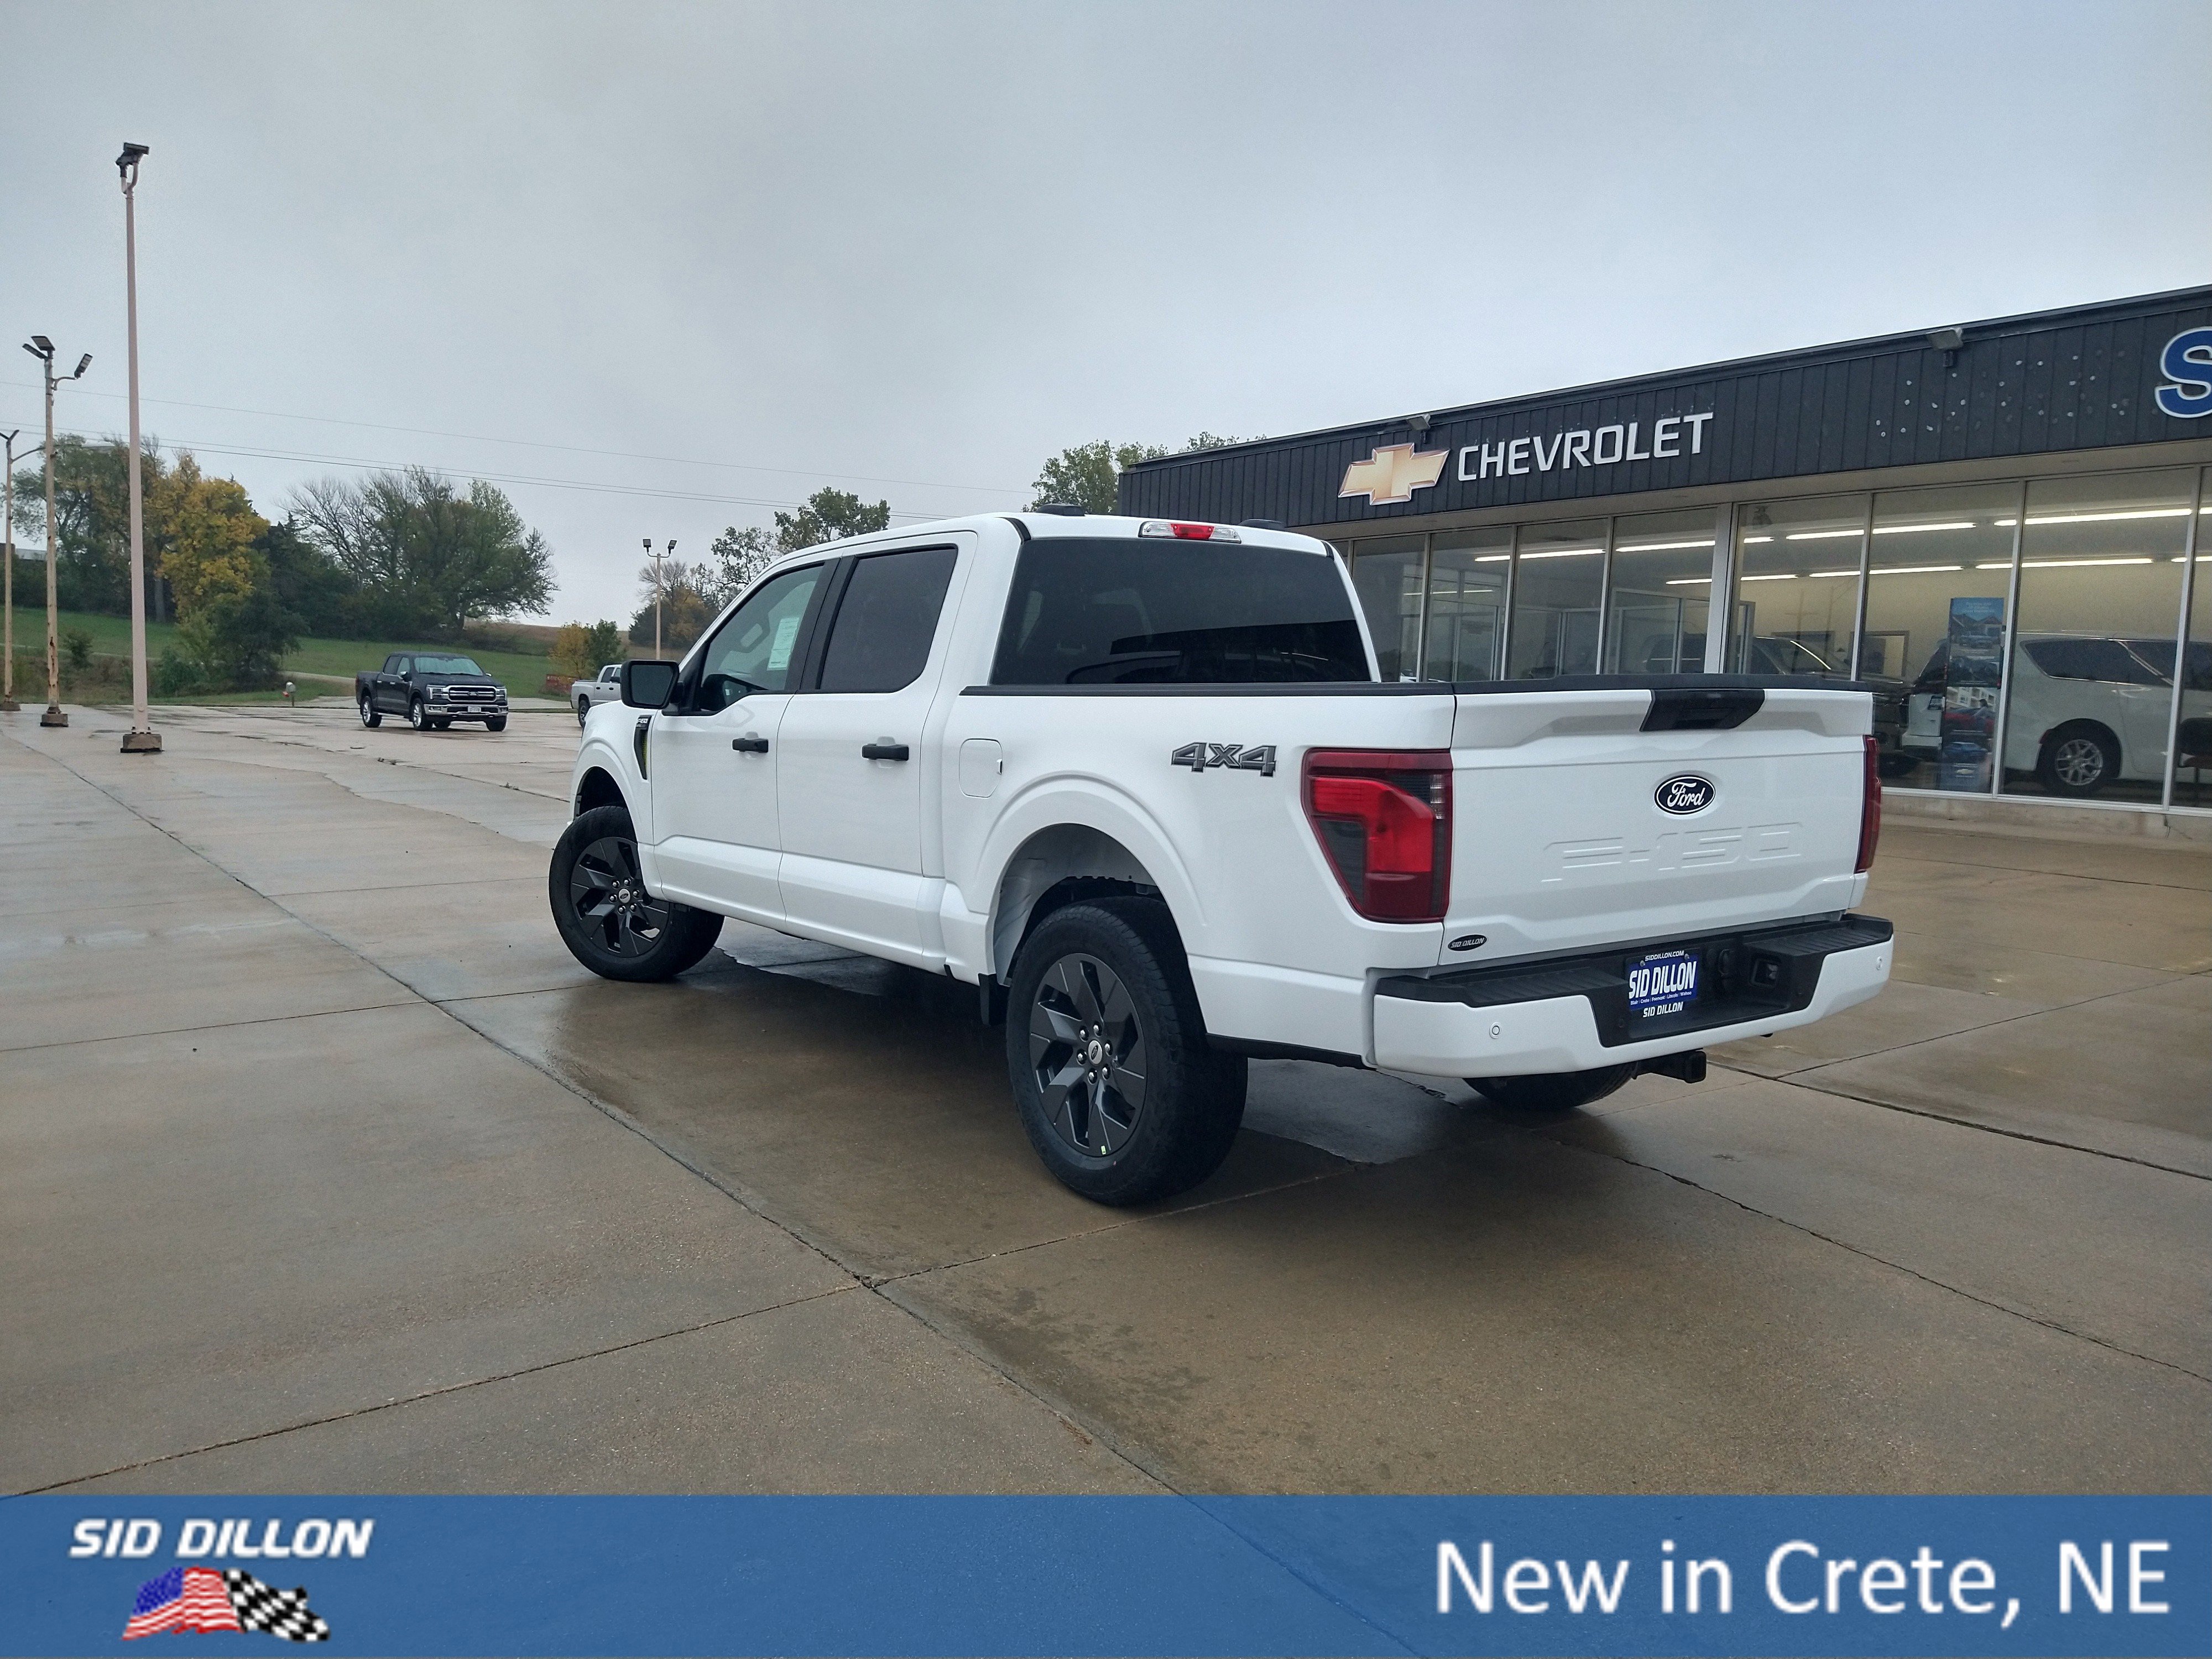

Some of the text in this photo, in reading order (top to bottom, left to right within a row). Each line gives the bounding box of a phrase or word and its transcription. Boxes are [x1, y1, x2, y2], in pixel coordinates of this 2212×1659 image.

[1458, 412, 1713, 481] CHEVROLET
[1667, 782, 1705, 807] Ford
[1462, 937, 1485, 946] DILLON
[1645, 950, 1684, 962] SIDDILLON.COM
[1629, 961, 1697, 999] SID DILLON
[1643, 1001, 1683, 1018] SID DILLON
